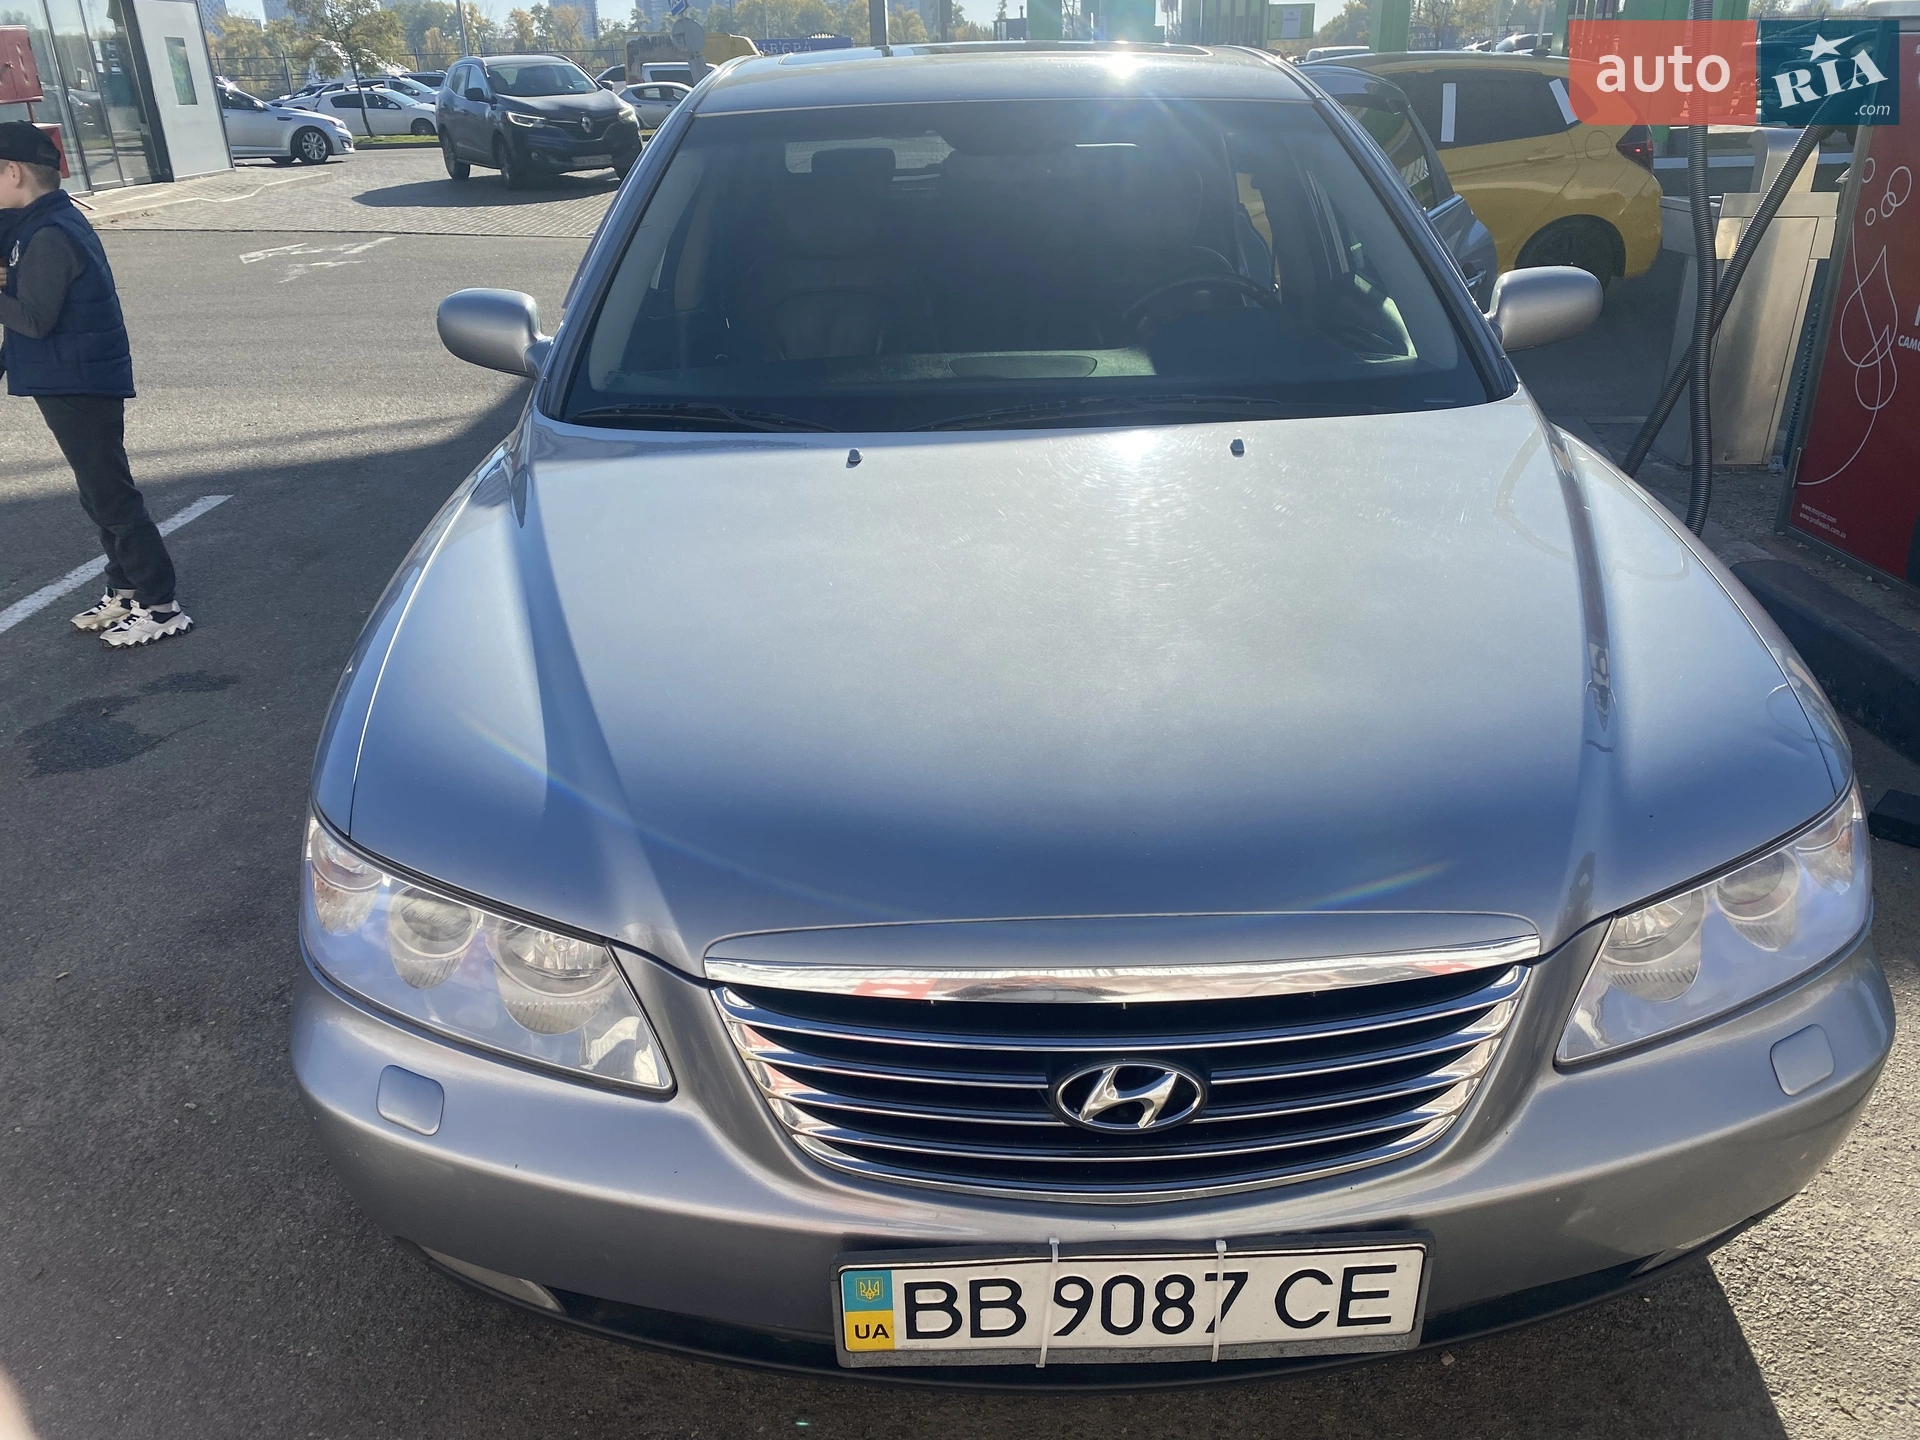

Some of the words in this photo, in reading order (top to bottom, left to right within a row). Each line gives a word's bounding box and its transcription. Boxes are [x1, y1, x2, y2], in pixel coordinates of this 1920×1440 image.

[904, 1277, 1027, 1340] BB
[1053, 1271, 1249, 1337] 9087
[1274, 1264, 1398, 1330] CE
[854, 1323, 890, 1340] UA
